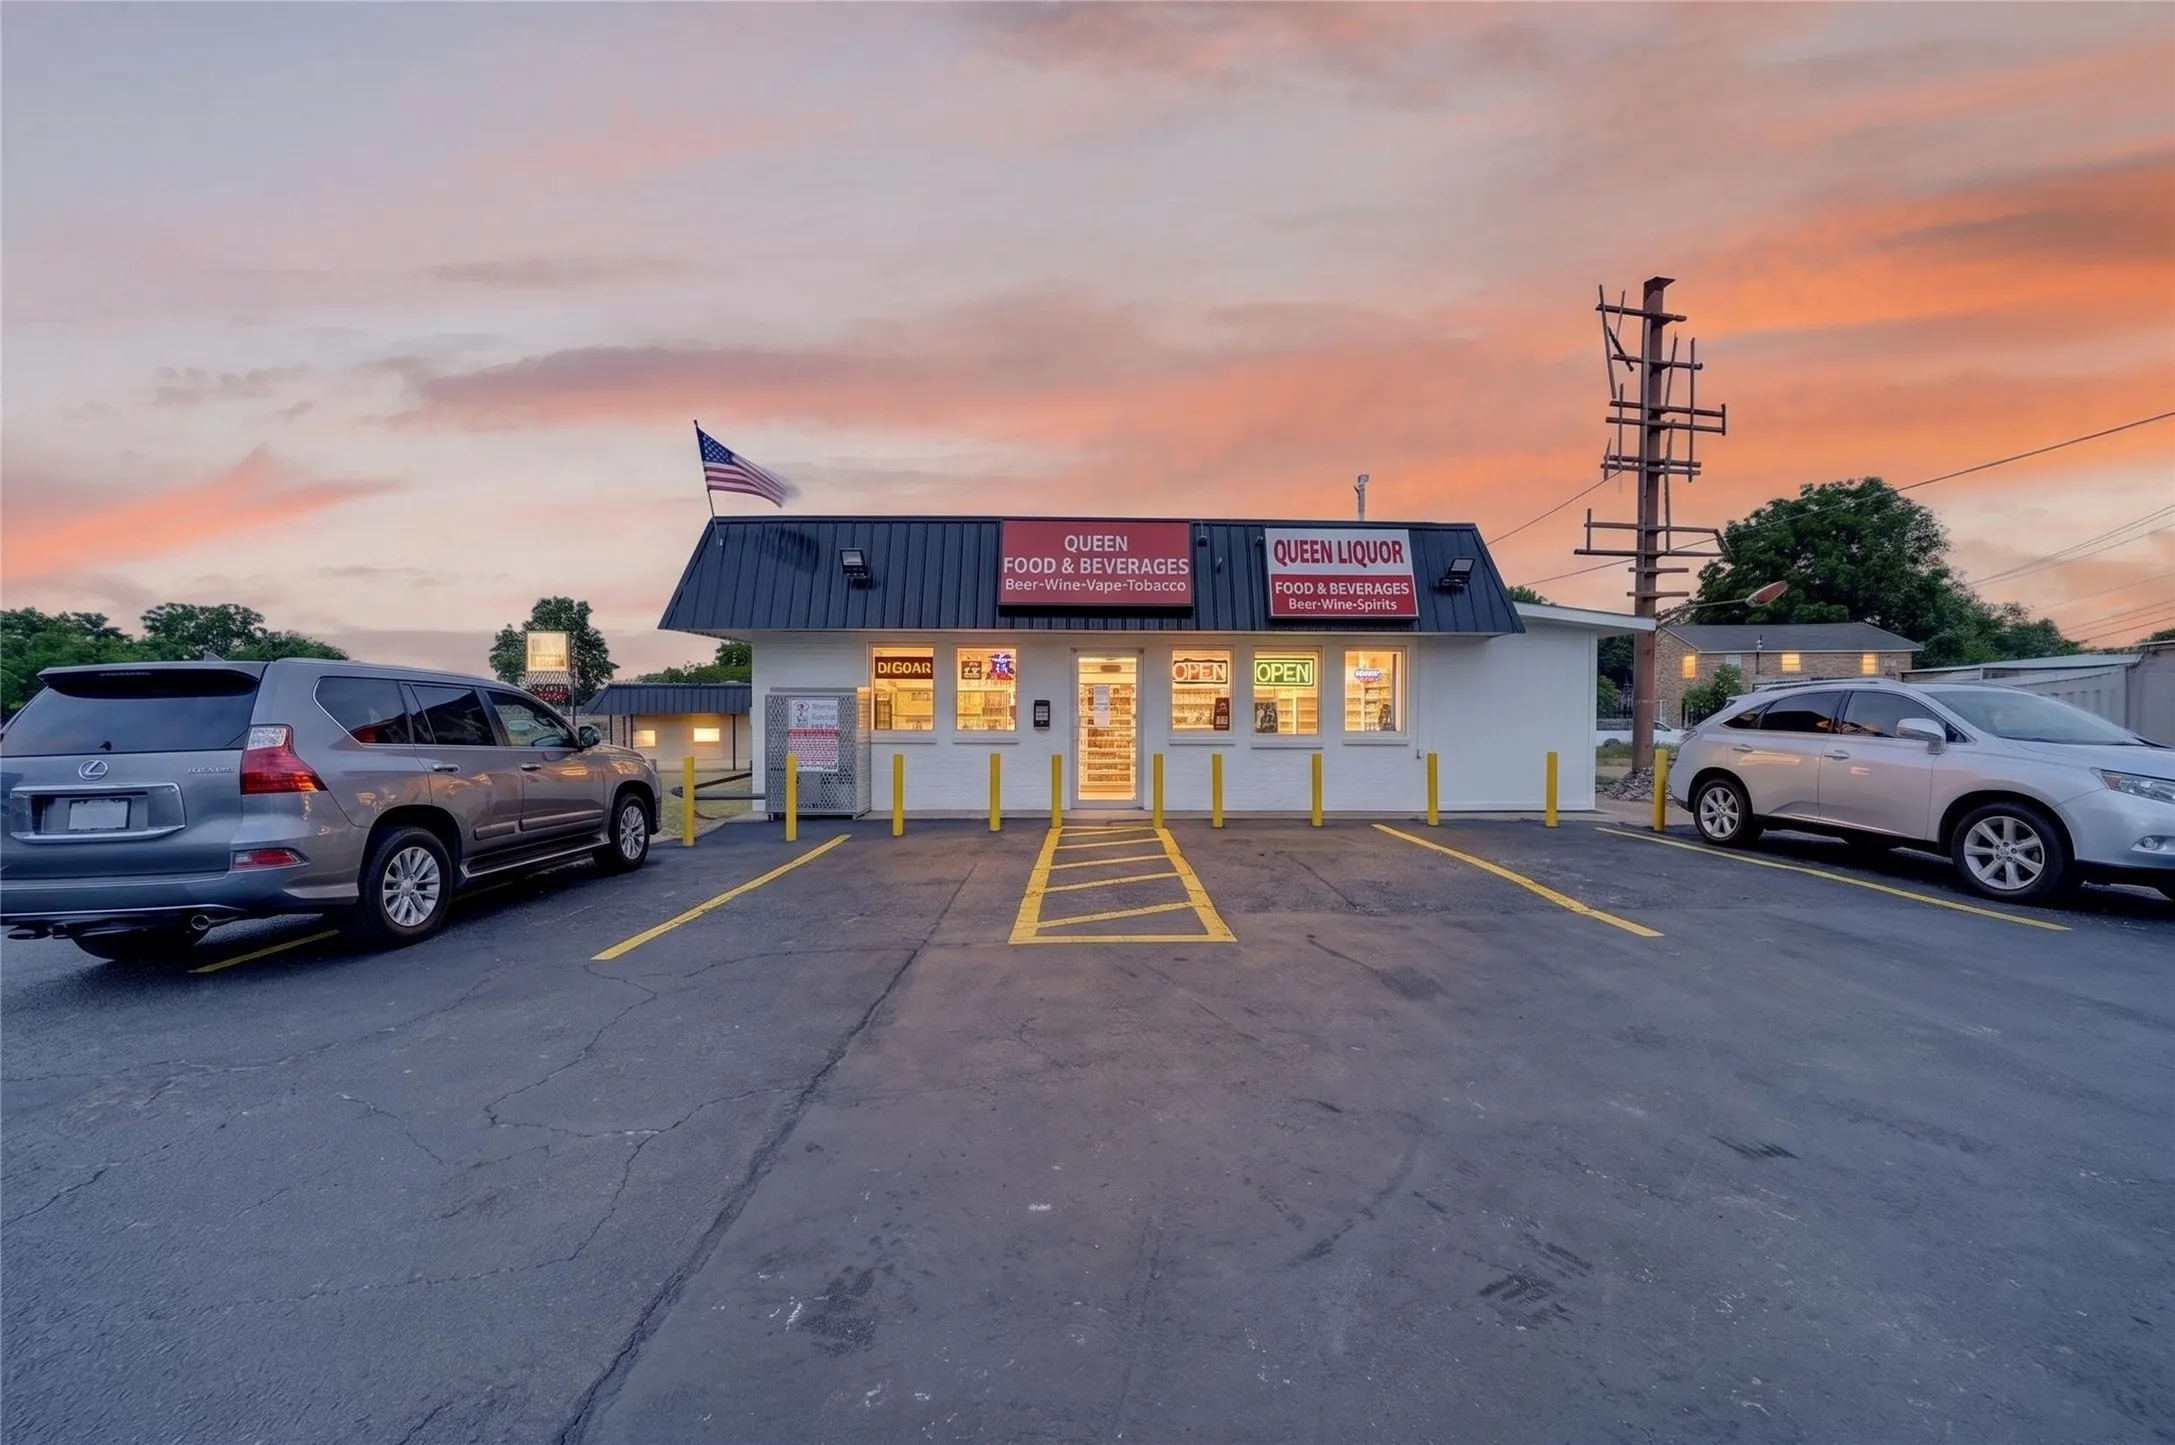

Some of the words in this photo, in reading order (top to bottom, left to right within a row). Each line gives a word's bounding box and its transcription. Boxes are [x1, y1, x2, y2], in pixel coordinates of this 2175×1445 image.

[1064, 535, 1128, 553] QUEEN
[1273, 539, 1333, 567] QUEEN
[1338, 540, 1404, 568] LIQUOR
[1003, 557, 1057, 574] FOOD
[1061, 557, 1074, 574] &
[1080, 558, 1190, 575] BEVERAGES
[1005, 578, 1187, 594] Beer-Wine-Vape-Tobacco
[1275, 581, 1314, 595] FOOD
[1317, 582, 1327, 595] &
[1330, 582, 1410, 595] BEVERAGES
[1173, 662, 1226, 681] OPEN
[1257, 663, 1310, 682] OPEN
